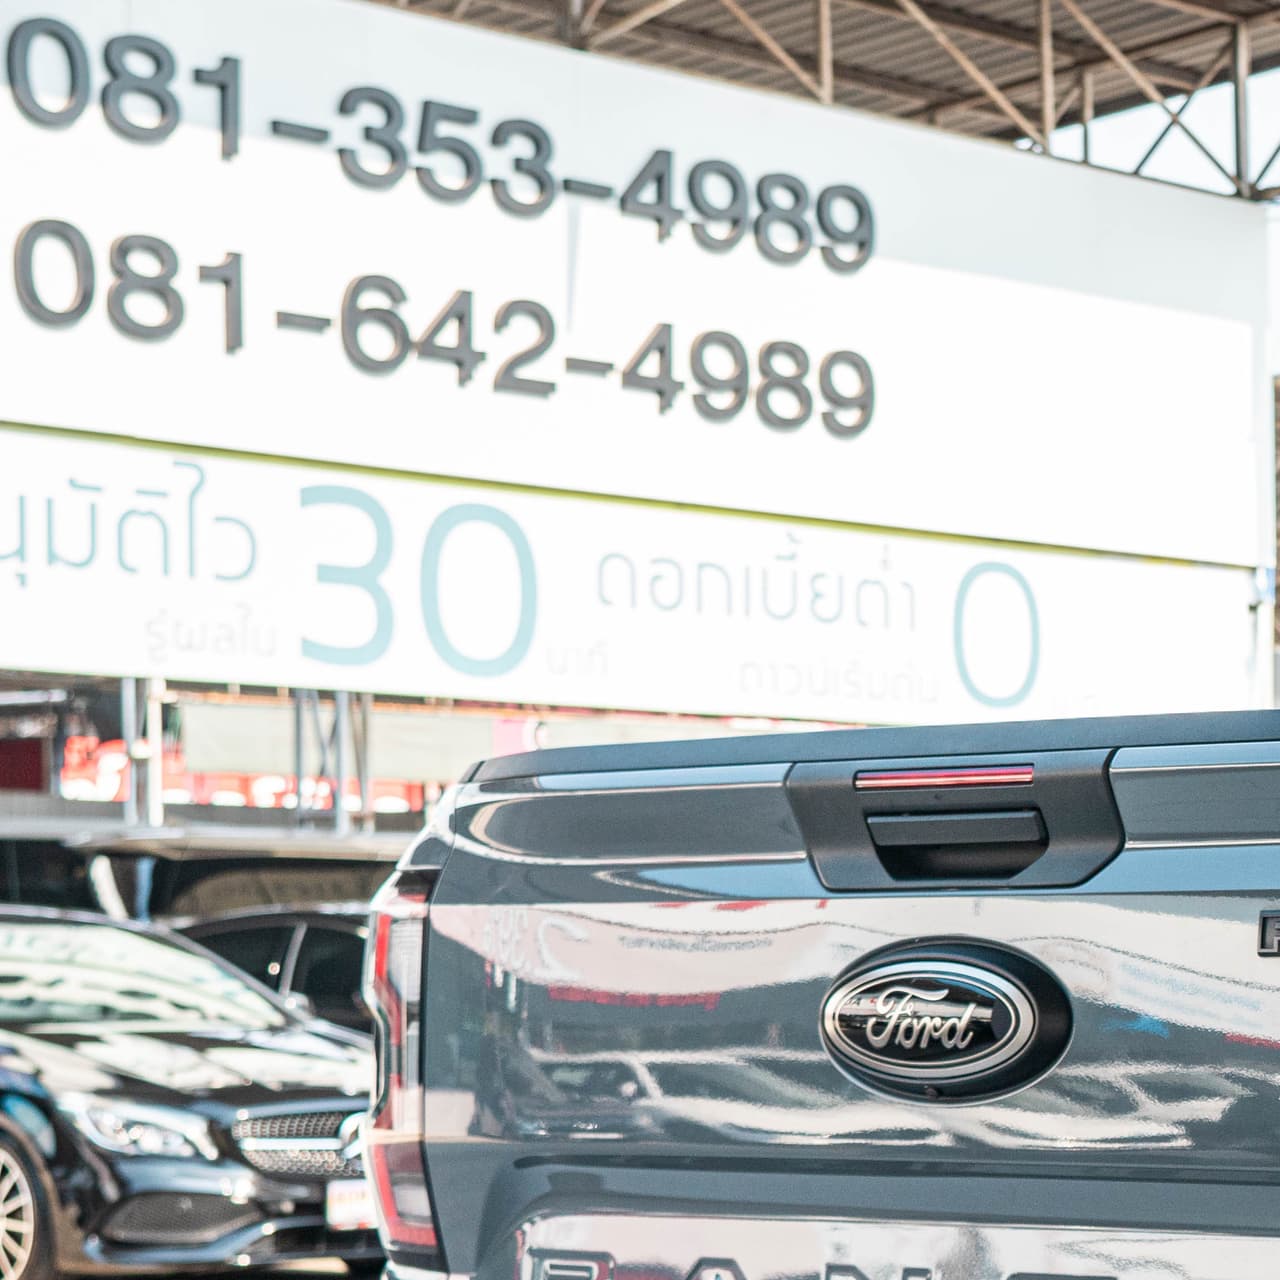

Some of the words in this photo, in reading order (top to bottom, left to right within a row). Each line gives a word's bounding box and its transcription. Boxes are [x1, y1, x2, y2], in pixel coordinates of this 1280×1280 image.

[5, 17, 877, 274] 081-353-4989
[13, 218, 876, 438] 081-642-4989
[298, 483, 541, 679] 30
[952, 560, 1042, 710] 0
[865, 986, 975, 1051] Ford
